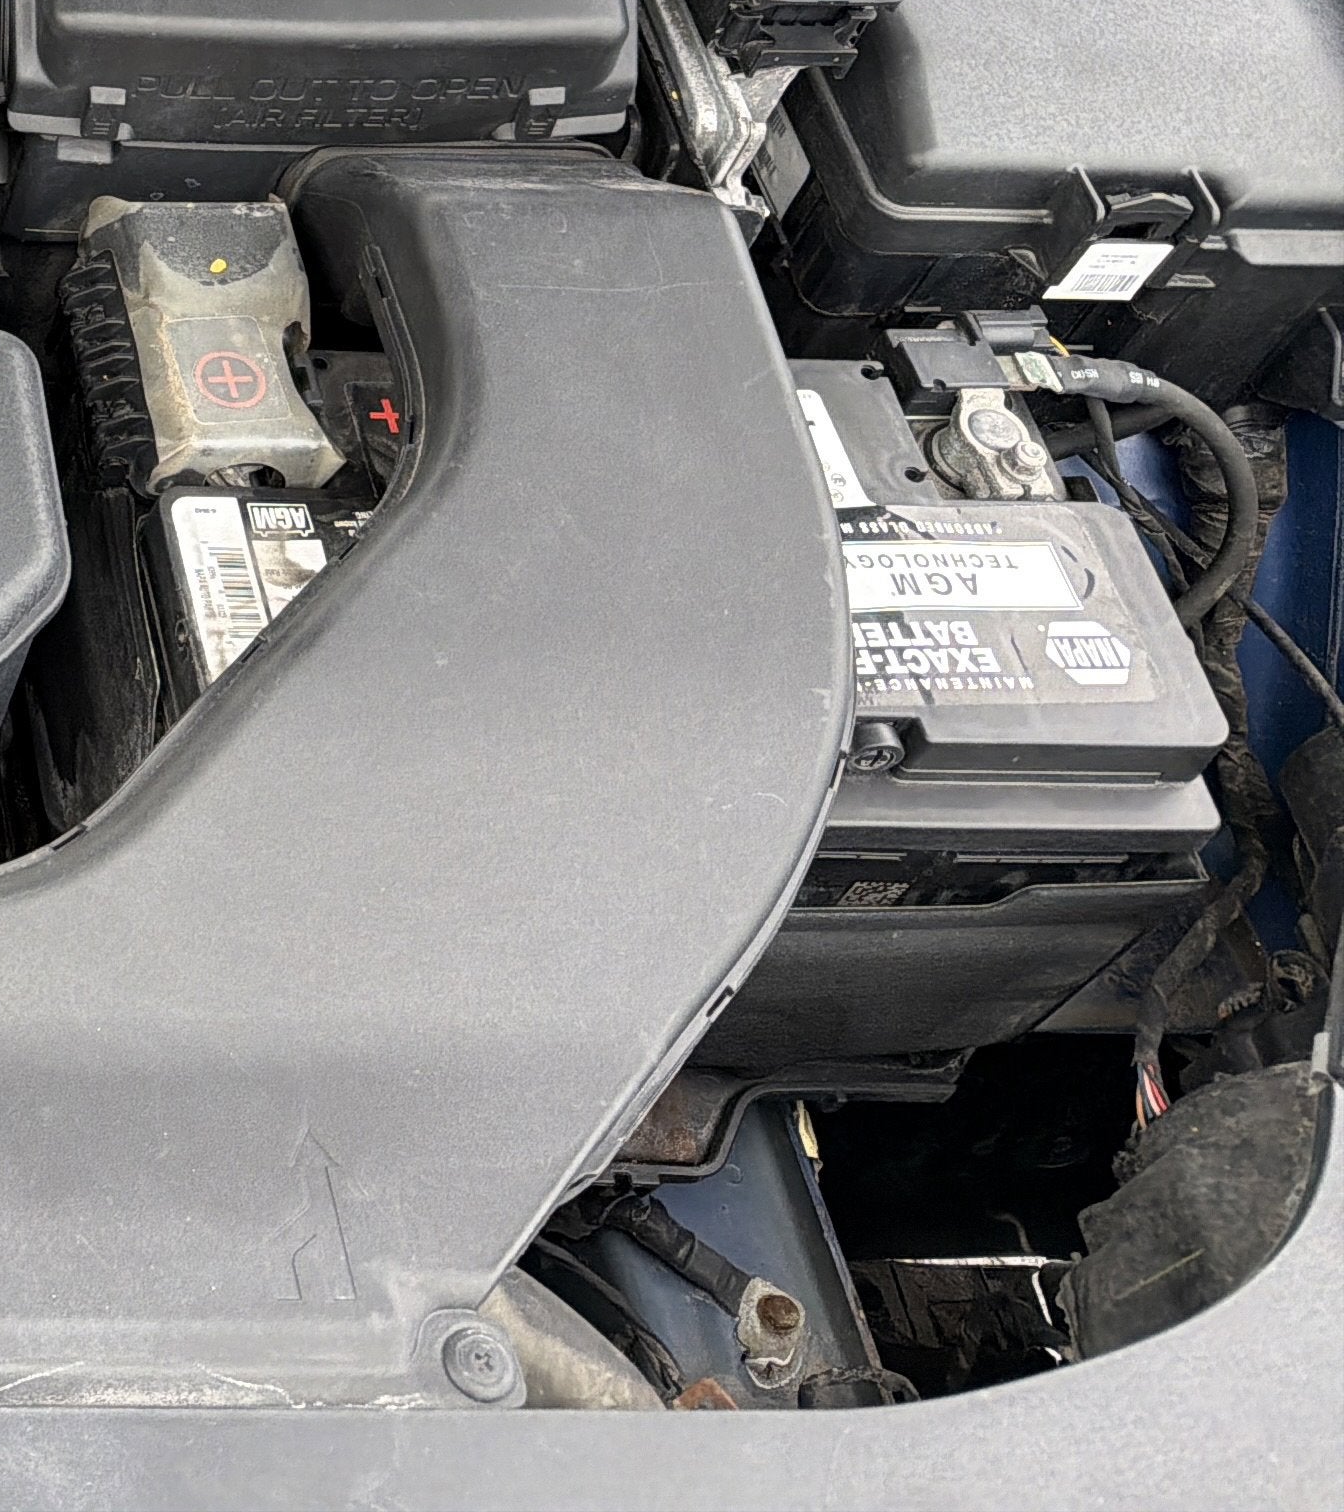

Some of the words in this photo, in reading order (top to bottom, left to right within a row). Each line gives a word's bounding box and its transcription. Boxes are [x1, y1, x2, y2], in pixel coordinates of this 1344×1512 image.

[131, 75, 235, 101] PULL
[249, 77, 338, 102] OUT
[348, 78, 399, 102] TO
[410, 75, 526, 101] OPEN
[252, 506, 307, 530] AGM
[843, 553, 1019, 569] TECHNOLOGY
[1053, 637, 1121, 669] NAPA
